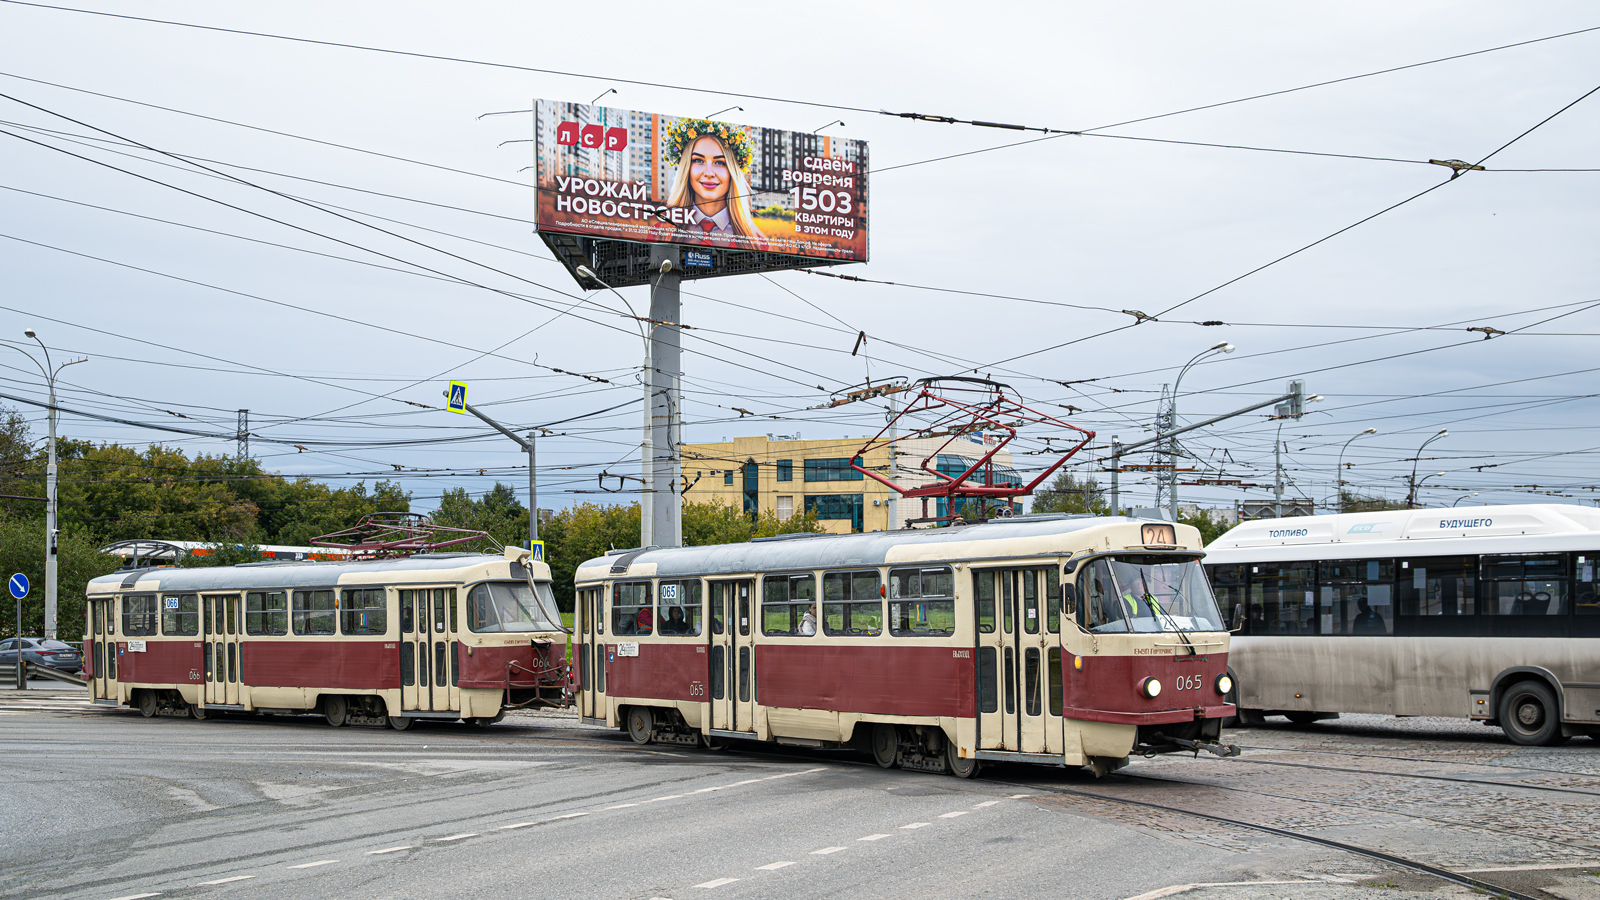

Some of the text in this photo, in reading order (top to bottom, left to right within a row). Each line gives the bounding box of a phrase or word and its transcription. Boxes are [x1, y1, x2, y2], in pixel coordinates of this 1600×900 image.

[560, 130, 618, 148] ЛСР
[803, 155, 853, 173] сдаём
[782, 169, 853, 189] вовремя
[556, 175, 647, 201] УРОЖАЙ
[789, 186, 852, 214] 1503
[557, 195, 697, 225] НОВОСТРОЕК
[555, 220, 585, 228] Подробности
[794, 212, 854, 228] КВАРТИРЫ
[795, 225, 855, 240] в этом году
[694, 252, 711, 260] Russ
[1440, 518, 1493, 529] БУДУЩЕГО
[1269, 528, 1308, 538] ТОПЛИВО
[662, 585, 676, 598] 065
[166, 598, 178, 608] 066
[532, 657, 550, 668] 06
[189, 670, 201, 680] 066
[1176, 674, 1203, 692] 065
[690, 684, 704, 697] 065
